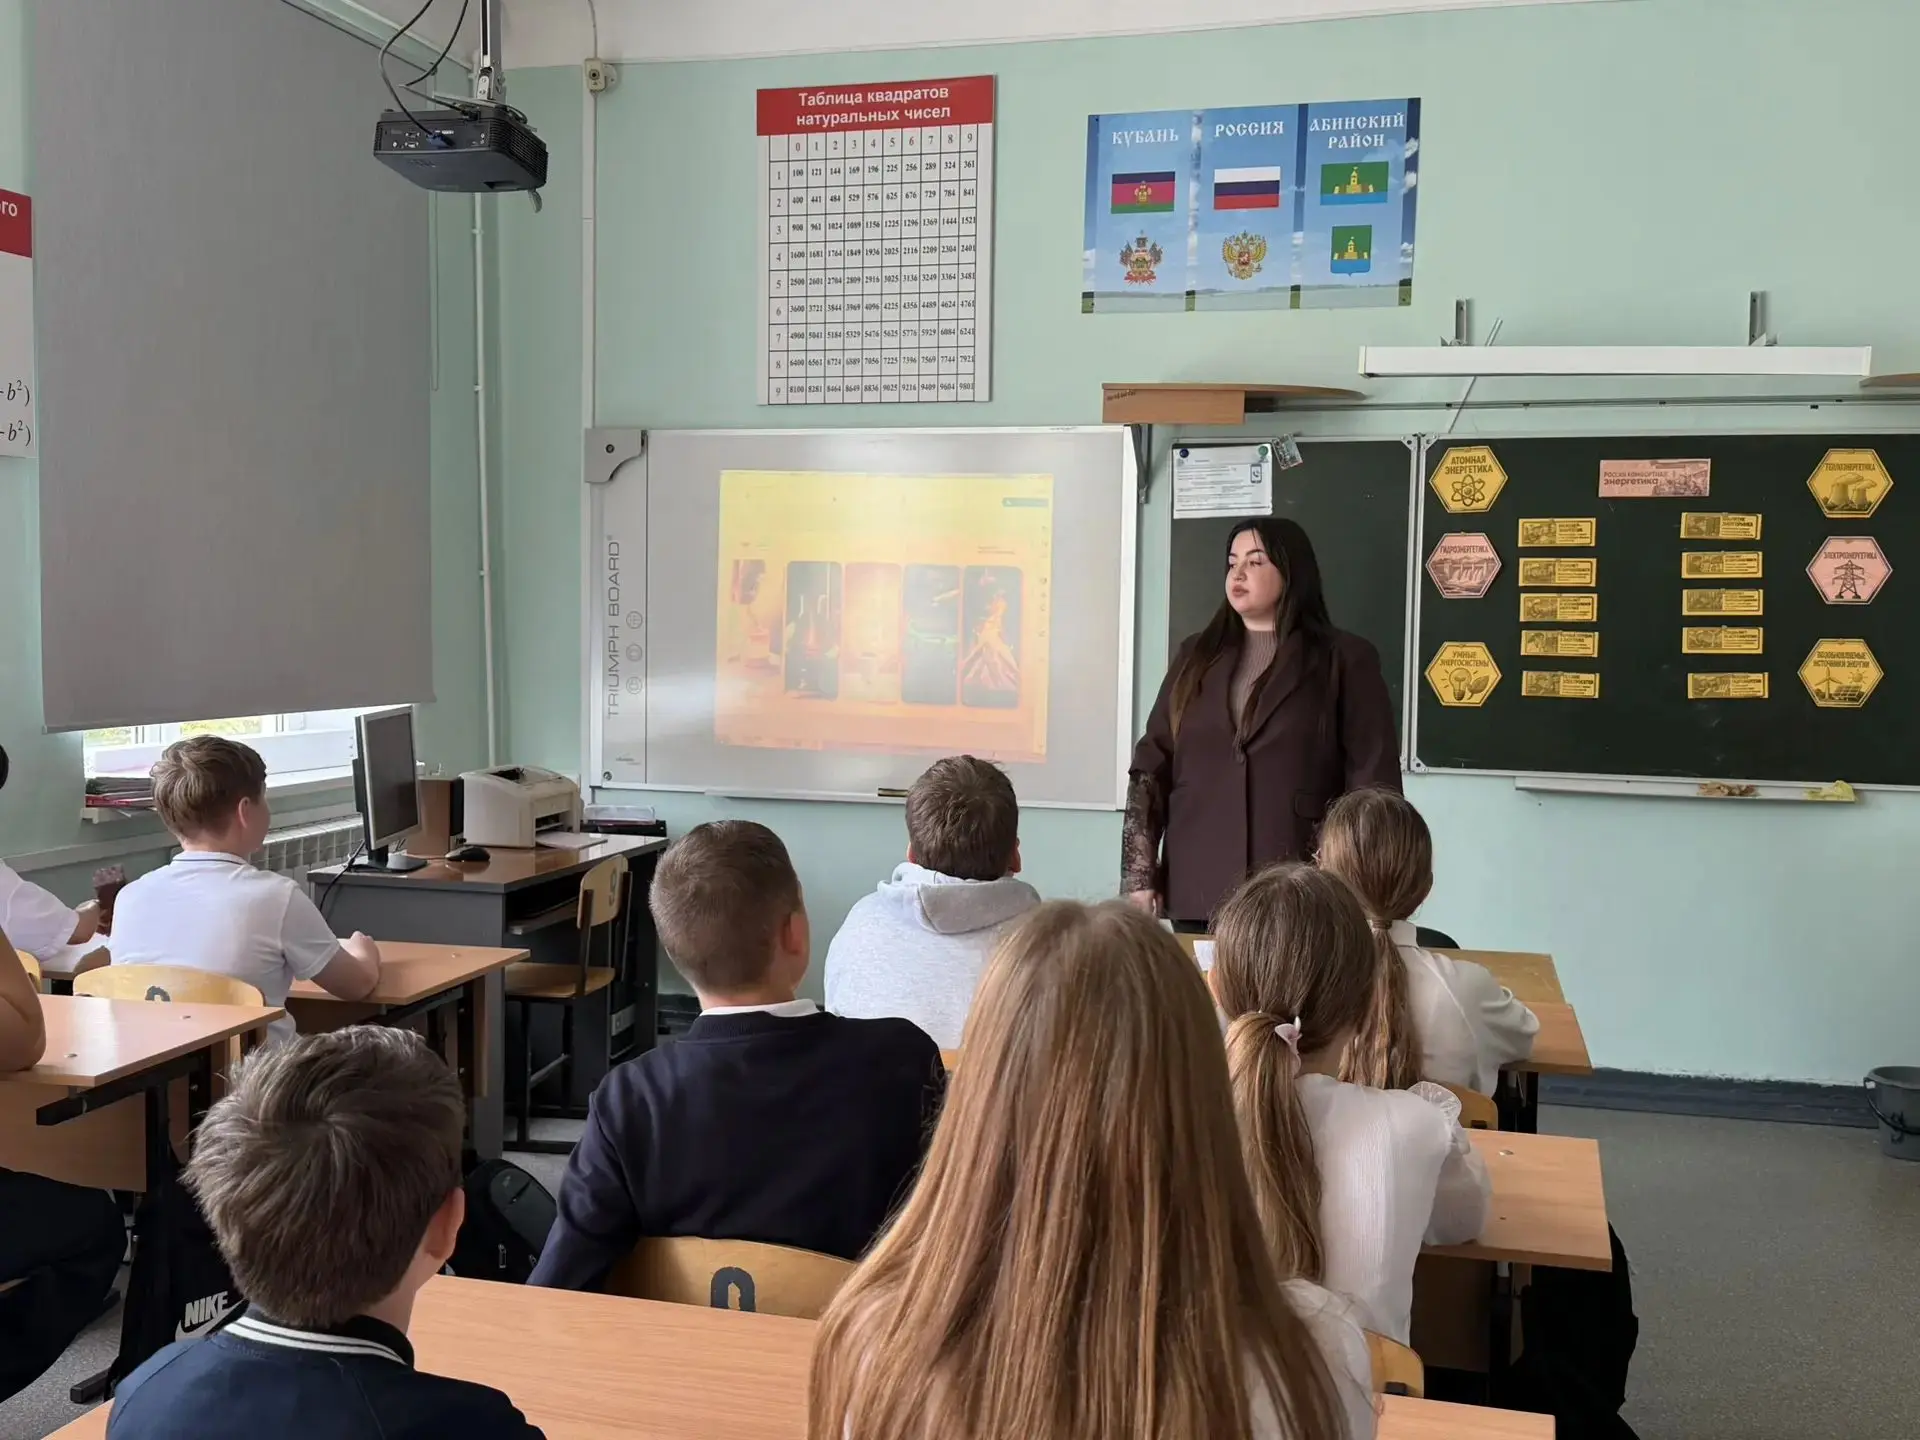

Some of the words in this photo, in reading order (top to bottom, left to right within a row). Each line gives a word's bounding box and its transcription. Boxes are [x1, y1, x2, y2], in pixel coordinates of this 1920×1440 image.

[798, 91, 863, 107] Таблица
[867, 86, 949, 104] квадратов
[796, 108, 900, 127] натуральных
[904, 106, 951, 120] чисел
[1309, 112, 1405, 131] АБИНСКИЙ
[1112, 128, 1179, 145] КУБАНЬ
[1214, 120, 1284, 137] РОССИЯ
[795, 142, 801, 153] 0
[814, 141, 819, 152] 1
[832, 140, 839, 151] 2
[851, 139, 857, 150] 3
[870, 138, 877, 149] 4
[889, 136, 896, 148] 5
[908, 135, 915, 147] 6
[927, 134, 934, 145] 7
[947, 133, 954, 145] 8
[966, 132, 973, 144] 9
[1328, 132, 1384, 149] РАЙОН
[777, 170, 781, 181] 1
[792, 168, 804, 178] 100
[811, 167, 822, 177] 121
[829, 166, 842, 176] 144
[848, 165, 861, 175] 169
[867, 164, 880, 174] 196
[886, 163, 899, 173] 225
[905, 162, 918, 172] 256
[924, 161, 937, 171] 289
[943, 160, 957, 170] 324
[963, 159, 976, 169] 361
[776, 197, 782, 208] 2
[810, 195, 822, 205] 441
[829, 194, 842, 203] 484
[847, 193, 861, 203] 529
[866, 192, 880, 202] 576
[904, 190, 918, 200] 676
[924, 189, 937, 199] 729
[943, 188, 957, 198] 784
[962, 187, 976, 197] 841
[775, 225, 782, 236] 3
[809, 222, 822, 232] 961
[827, 221, 843, 231] 1024
[865, 220, 881, 229] 1156
[884, 219, 900, 228] 1225
[903, 218, 919, 228] 1296
[922, 217, 938, 227] 1369
[942, 216, 957, 226] 1444
[961, 215, 976, 225] 1521
[775, 252, 782, 263] 4
[790, 250, 806, 260] 1600
[809, 249, 824, 259] 1681
[827, 249, 843, 258] 1764
[846, 248, 861, 257] 1849
[865, 247, 880, 257] 1936
[903, 246, 918, 255] 2116
[922, 245, 938, 255] 2209
[941, 244, 957, 254] 2304
[960, 243, 976, 253] 2401
[775, 279, 782, 290] 5
[790, 277, 805, 287] 2500
[827, 276, 843, 285] 2704
[846, 275, 861, 285] 2809
[864, 275, 880, 284] 2916
[902, 273, 918, 283] 3136
[921, 272, 937, 282] 3249
[940, 272, 957, 281] 3364
[960, 271, 975, 281] 3481
[775, 306, 782, 317] 6
[789, 304, 805, 313] 3600
[808, 304, 823, 313] 3721
[827, 303, 842, 313] 3844
[846, 303, 861, 312] 3969
[864, 302, 880, 311] 4096
[883, 301, 899, 311] 4225
[921, 300, 937, 309] 4489
[940, 300, 956, 309] 4624
[959, 299, 975, 309] 4761
[775, 332, 782, 344] 7
[789, 331, 805, 340] 4900
[808, 331, 823, 340] 5041
[827, 330, 842, 339] 5184
[845, 330, 861, 339] 5329
[883, 329, 899, 338] 5625
[902, 328, 918, 337] 5776
[921, 327, 937, 337] 5929
[959, 327, 975, 336] 6241
[775, 359, 782, 370] 8
[789, 358, 805, 367] 6400
[808, 358, 823, 367] 6561
[864, 356, 879, 365] 7056
[882, 356, 899, 365] 7225
[920, 355, 937, 364] 7569
[940, 355, 956, 364] 7744
[959, 354, 974, 363] 7921
[775, 386, 782, 397] 9
[789, 385, 805, 394] 8100
[845, 384, 860, 393] 8649
[863, 383, 879, 393] 8836
[882, 383, 898, 392] 9025
[902, 383, 917, 392] 9216
[939, 382, 955, 391] 9604
[958, 382, 974, 392] 9801
[1451, 455, 1486, 465] АТОМНАЯ
[1444, 465, 1493, 475] ЭНЕРГЕТИКА
[1603, 478, 1658, 487] энергетика
[1440, 545, 1489, 554] ГИДРОЭНЕРГЕТИКА
[608, 542, 620, 616] BOARD
[1452, 650, 1477, 659] УМНЫЕ
[608, 625, 620, 720] TRIUMPH
[184, 1291, 229, 1328] NIKE
